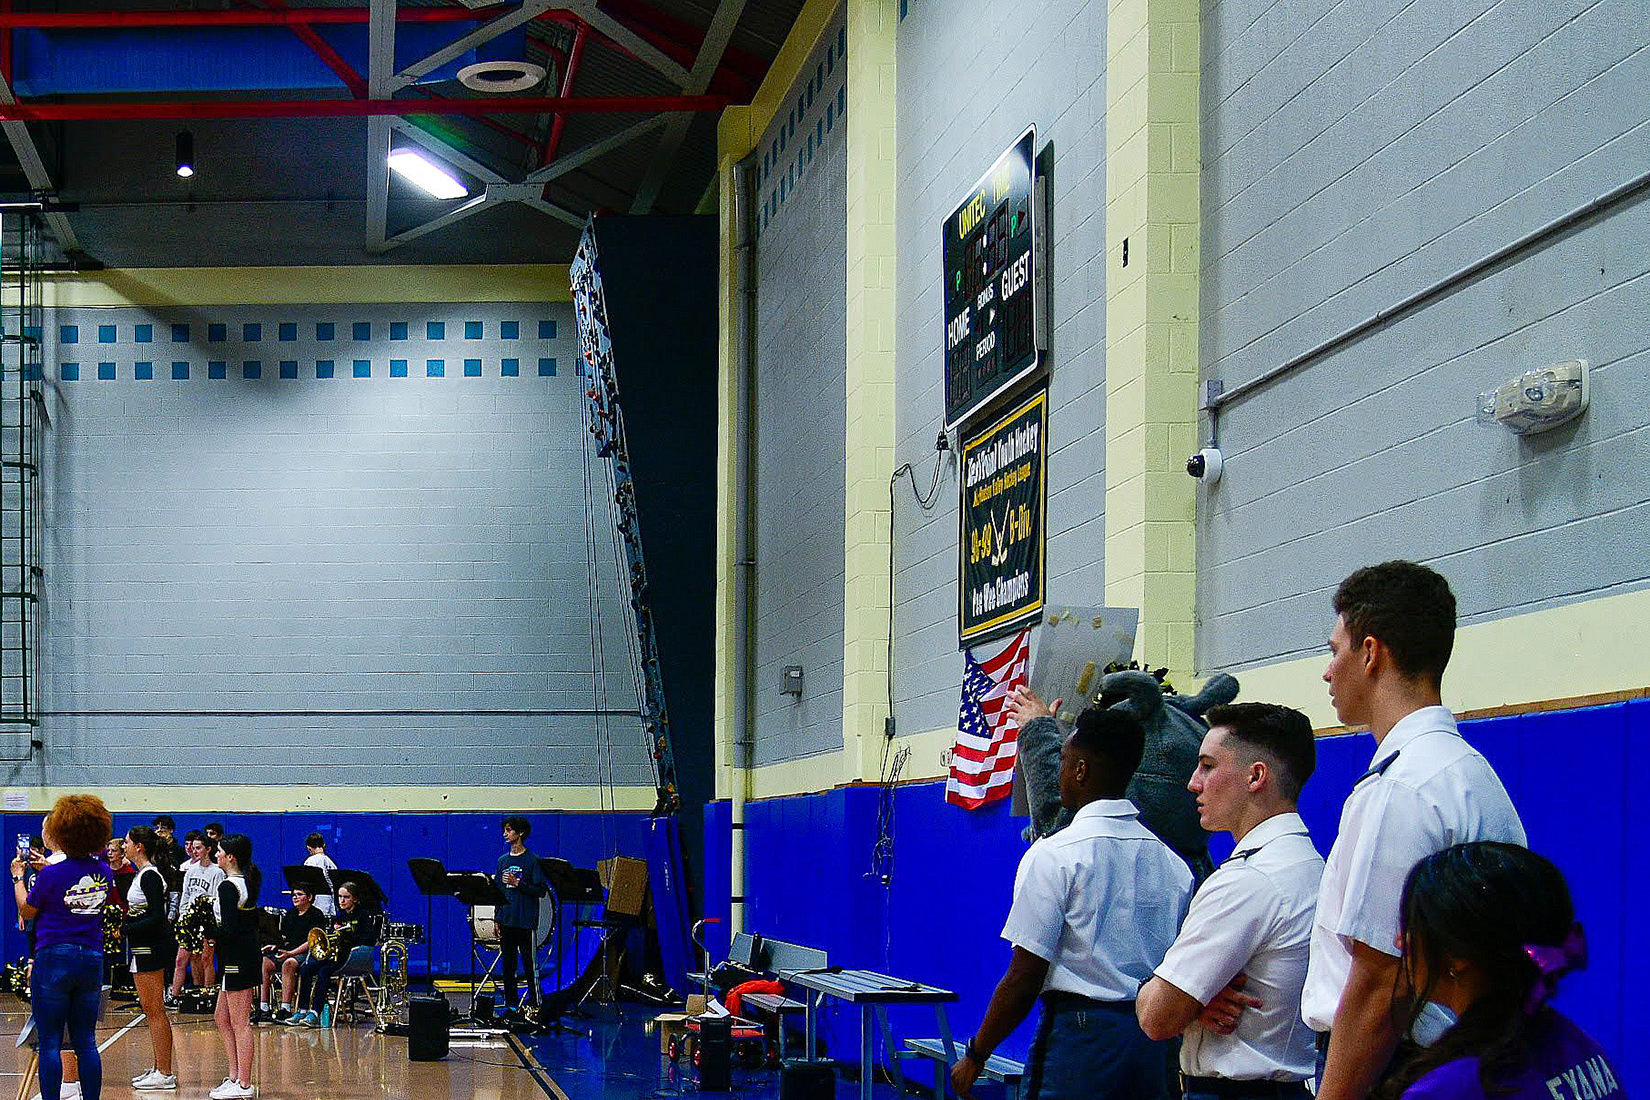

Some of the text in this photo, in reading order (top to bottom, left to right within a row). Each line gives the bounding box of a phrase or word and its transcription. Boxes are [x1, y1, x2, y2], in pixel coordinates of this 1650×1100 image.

[1001, 249, 1030, 301] GUEST
[948, 306, 970, 350] HOME
[976, 330, 995, 361] PERIOD
[996, 568, 1029, 607] Champions
